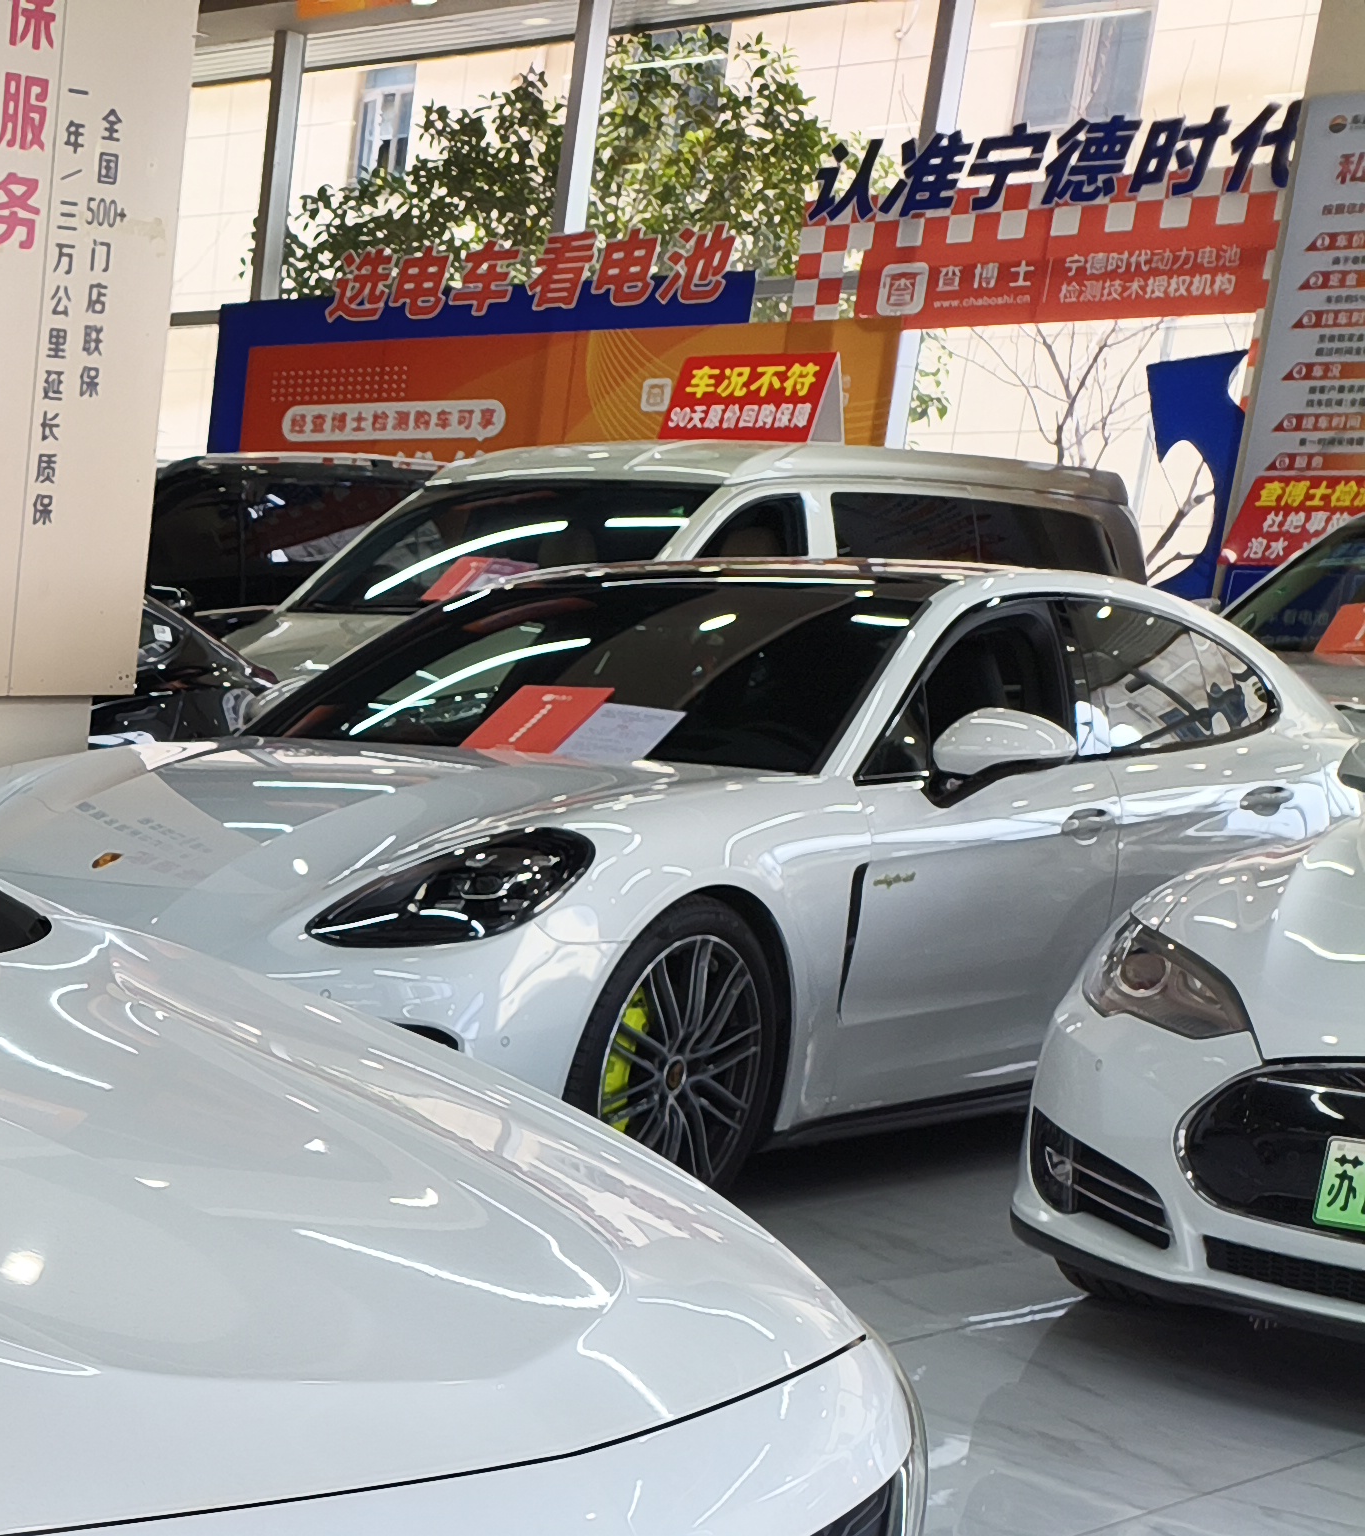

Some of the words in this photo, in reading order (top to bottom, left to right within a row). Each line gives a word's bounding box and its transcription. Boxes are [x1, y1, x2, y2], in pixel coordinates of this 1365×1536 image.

[808, 100, 1303, 223] 认准宁德时代
[325, 221, 737, 323] 选电车看电池
[936, 260, 1035, 292] 查博士
[1064, 244, 1241, 277] 宁德时代动力电池
[1059, 272, 1236, 304] 检测技术授权机构
[685, 362, 820, 398] 车况不符
[1326, 1153, 1365, 1215] 苏
